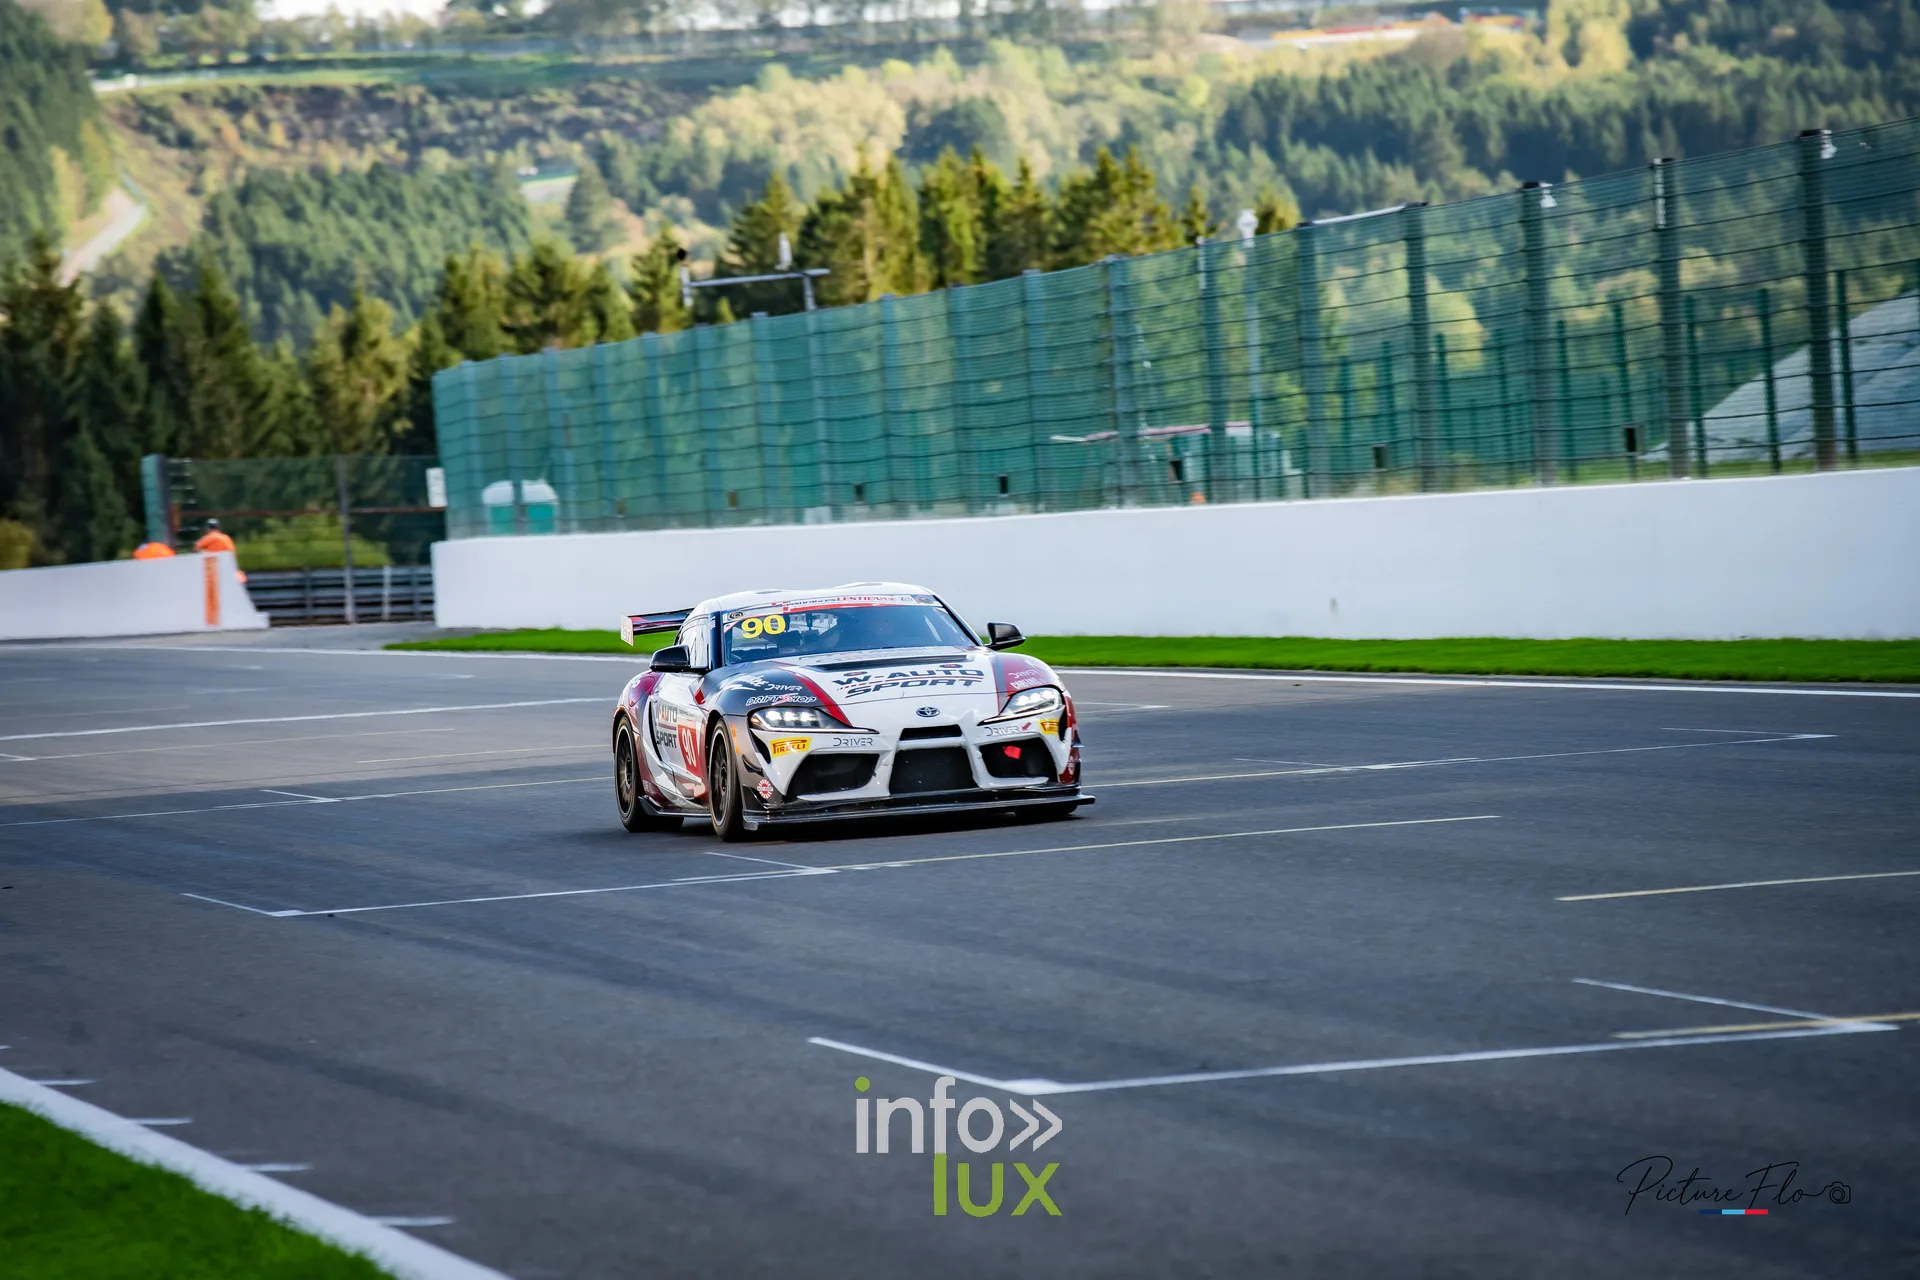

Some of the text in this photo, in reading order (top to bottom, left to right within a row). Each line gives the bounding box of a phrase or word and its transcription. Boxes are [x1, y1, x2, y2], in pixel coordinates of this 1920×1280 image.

[741, 614, 786, 639] 90
[832, 669, 985, 686] W-AUTO
[845, 678, 982, 698] SPORT
[656, 730, 677, 748] SPORT
[984, 725, 1020, 736] DRIVER
[681, 727, 697, 767] 90
[772, 739, 808, 755] PIRELLI
[833, 737, 873, 747] DRIVER
